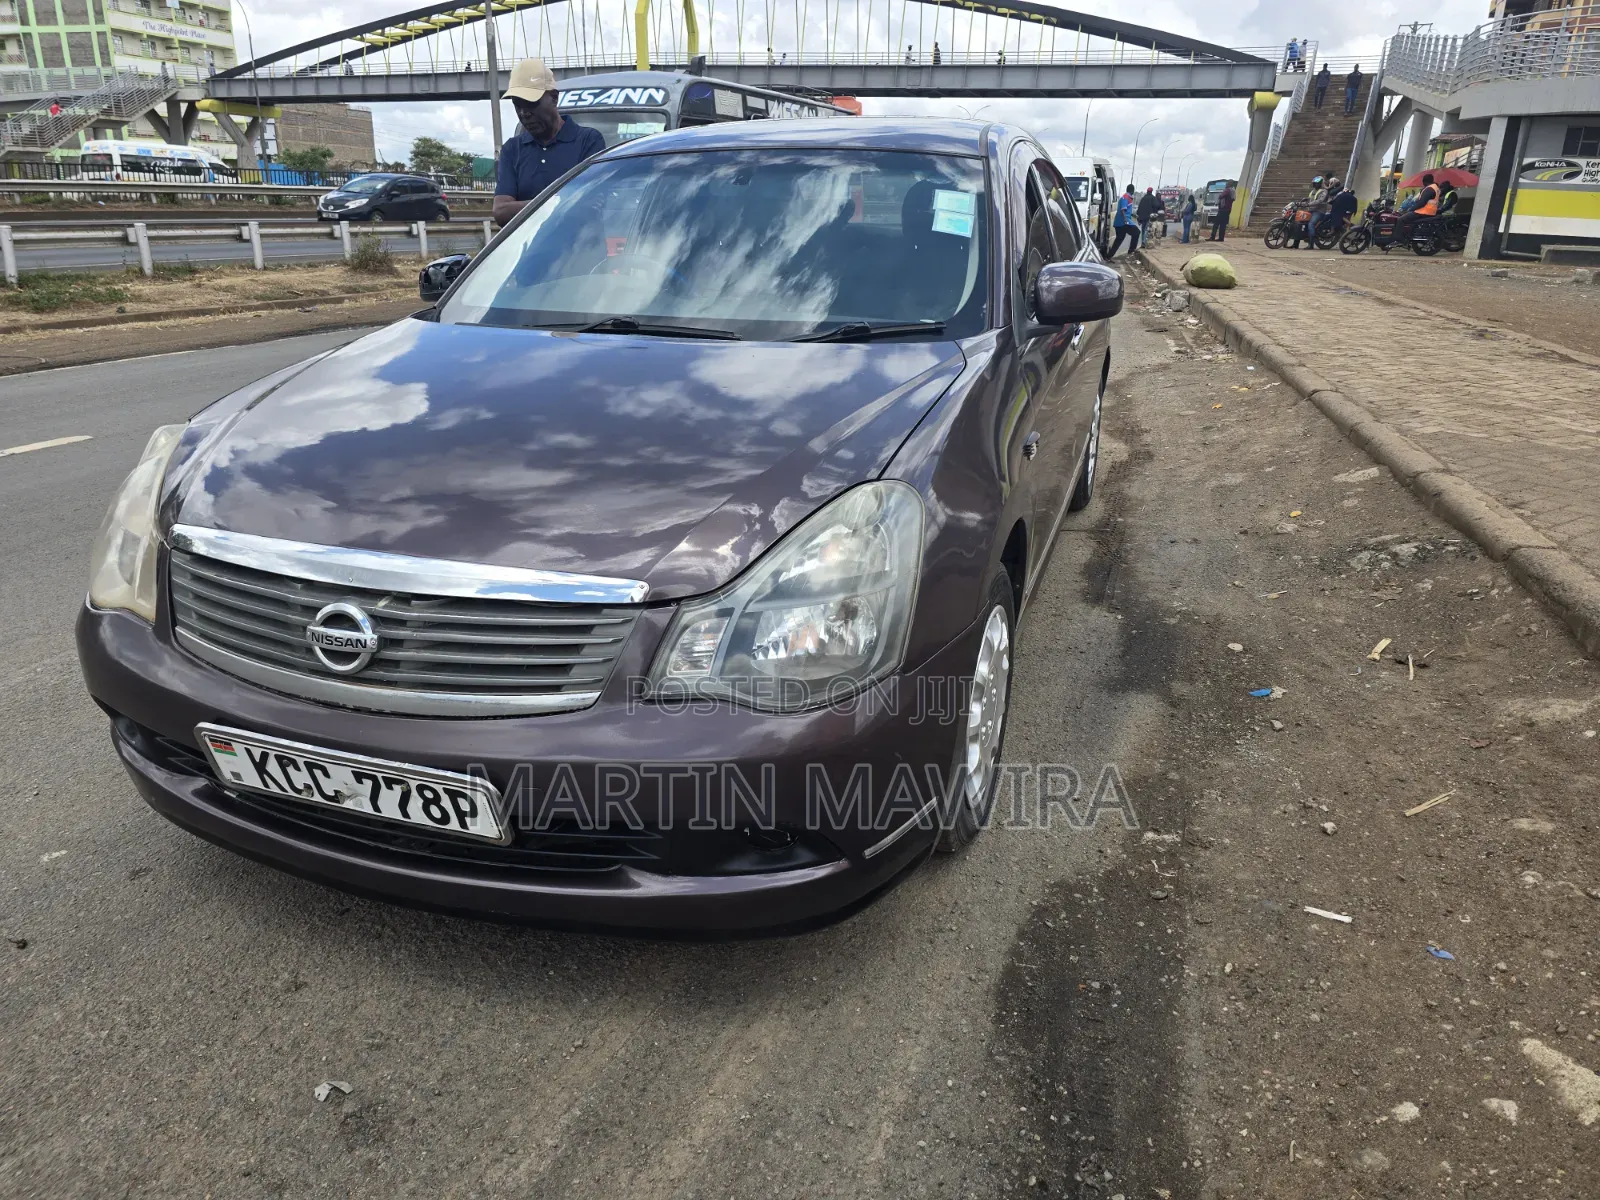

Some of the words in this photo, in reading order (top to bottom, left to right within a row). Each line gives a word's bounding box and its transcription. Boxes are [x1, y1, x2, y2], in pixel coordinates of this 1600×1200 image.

[143, 20, 156, 30] The
[157, 23, 189, 36] Highpoint
[311, 631, 367, 649] NISSAN
[244, 746, 345, 805] KCC
[351, 769, 478, 831] 778P
